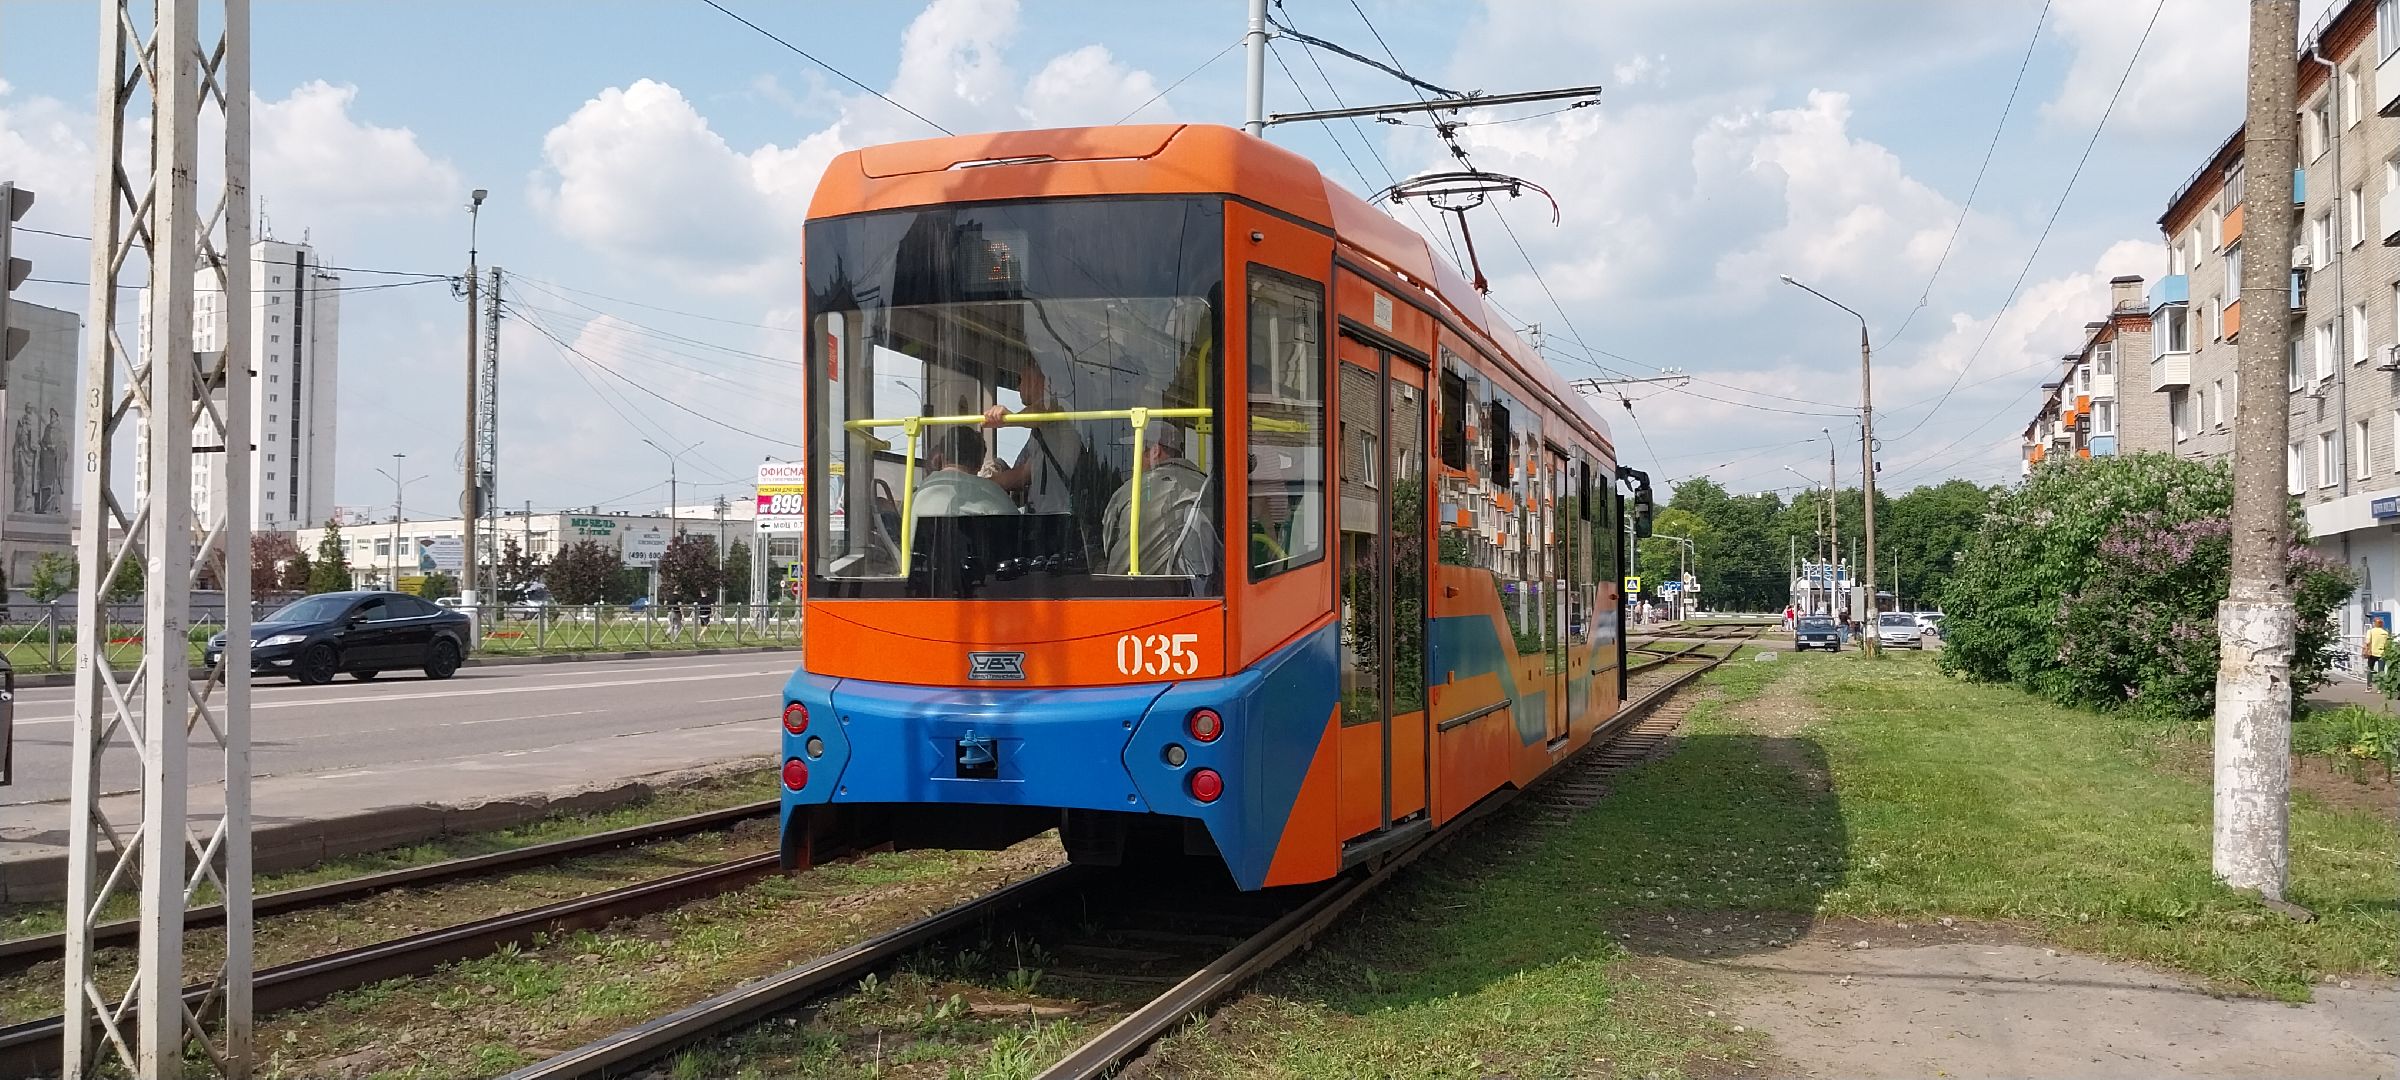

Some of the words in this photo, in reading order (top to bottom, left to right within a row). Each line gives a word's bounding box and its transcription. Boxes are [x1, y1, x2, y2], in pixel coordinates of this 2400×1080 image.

[87, 387, 100, 472] 378
[770, 494, 803, 514] 899
[571, 518, 616, 528] МЕБЕЛЬ
[628, 551, 647, 560] (499)
[1117, 633, 1199, 676] 035
